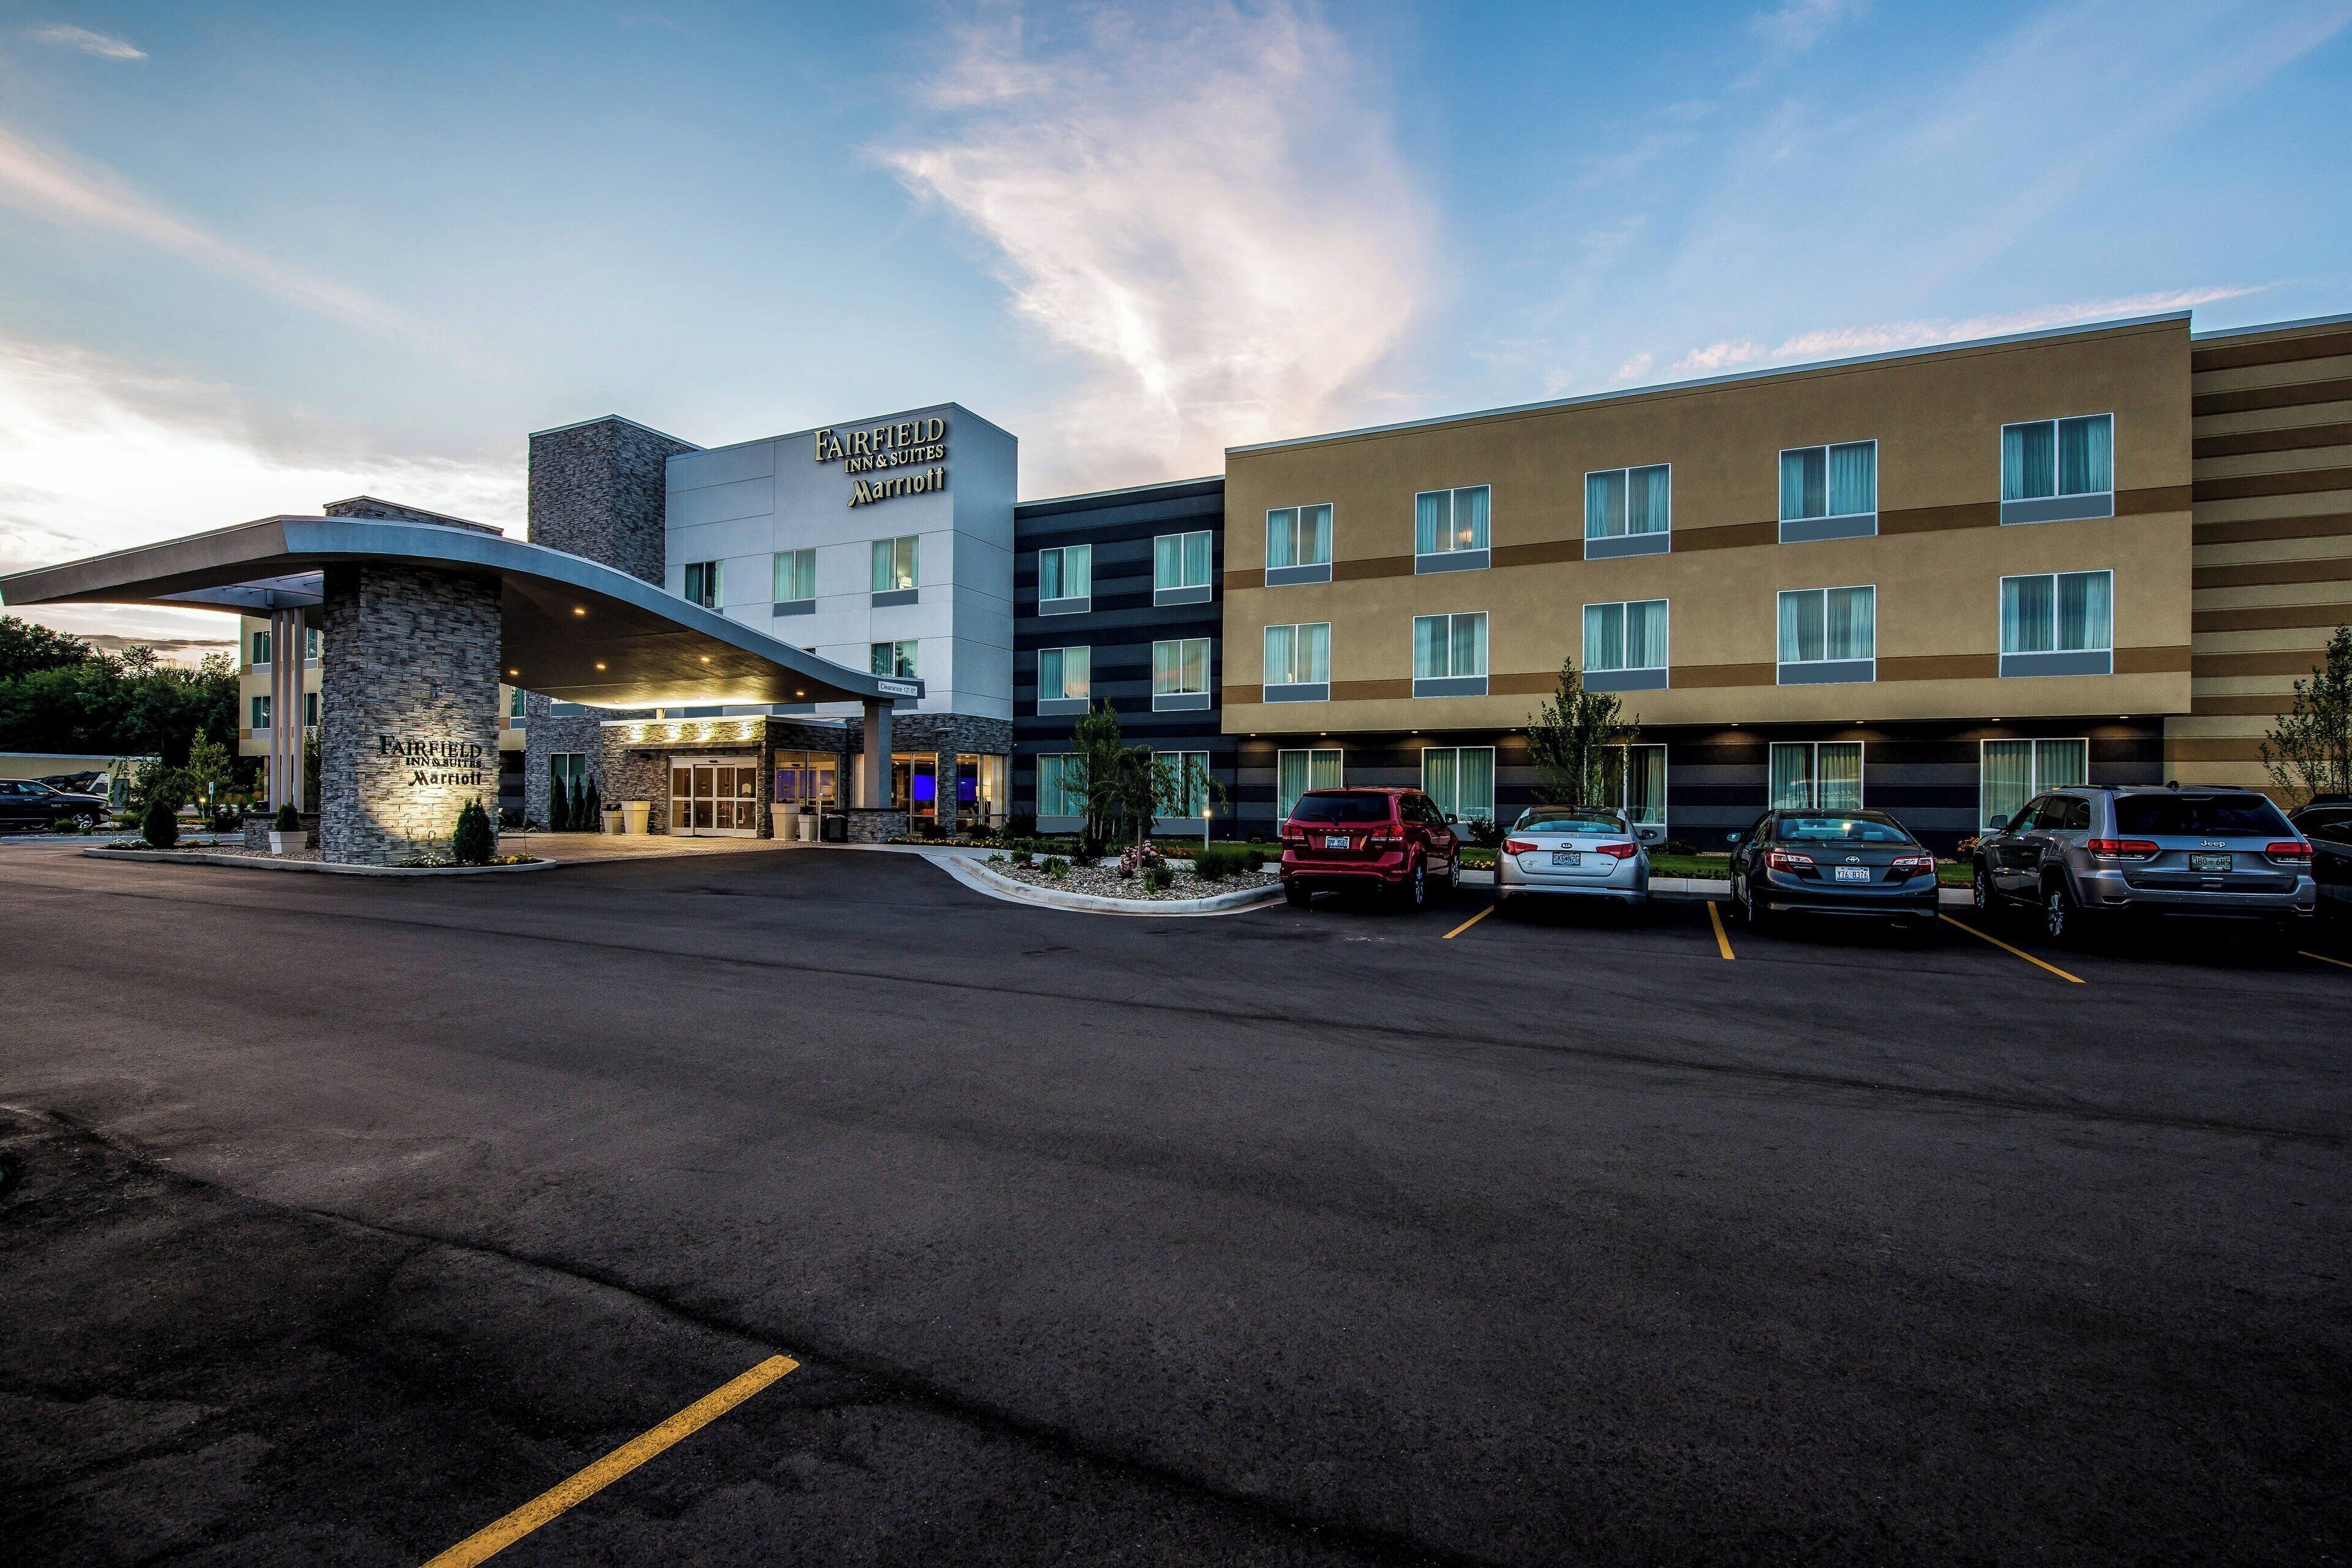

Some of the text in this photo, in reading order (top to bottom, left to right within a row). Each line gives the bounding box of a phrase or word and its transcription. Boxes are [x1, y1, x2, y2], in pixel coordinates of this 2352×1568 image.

[814, 418, 946, 462] FAIRFIELD
[844, 455, 873, 473] INN
[890, 444, 945, 466] SUITES
[846, 466, 944, 507] Marriott
[880, 683, 902, 692] Clearance
[379, 735, 483, 758] FAIRFIELD
[405, 757, 430, 766] INN
[442, 758, 483, 768] SUITES
[408, 769, 482, 786] Marriott
[2199, 840, 2226, 848] Jeep
